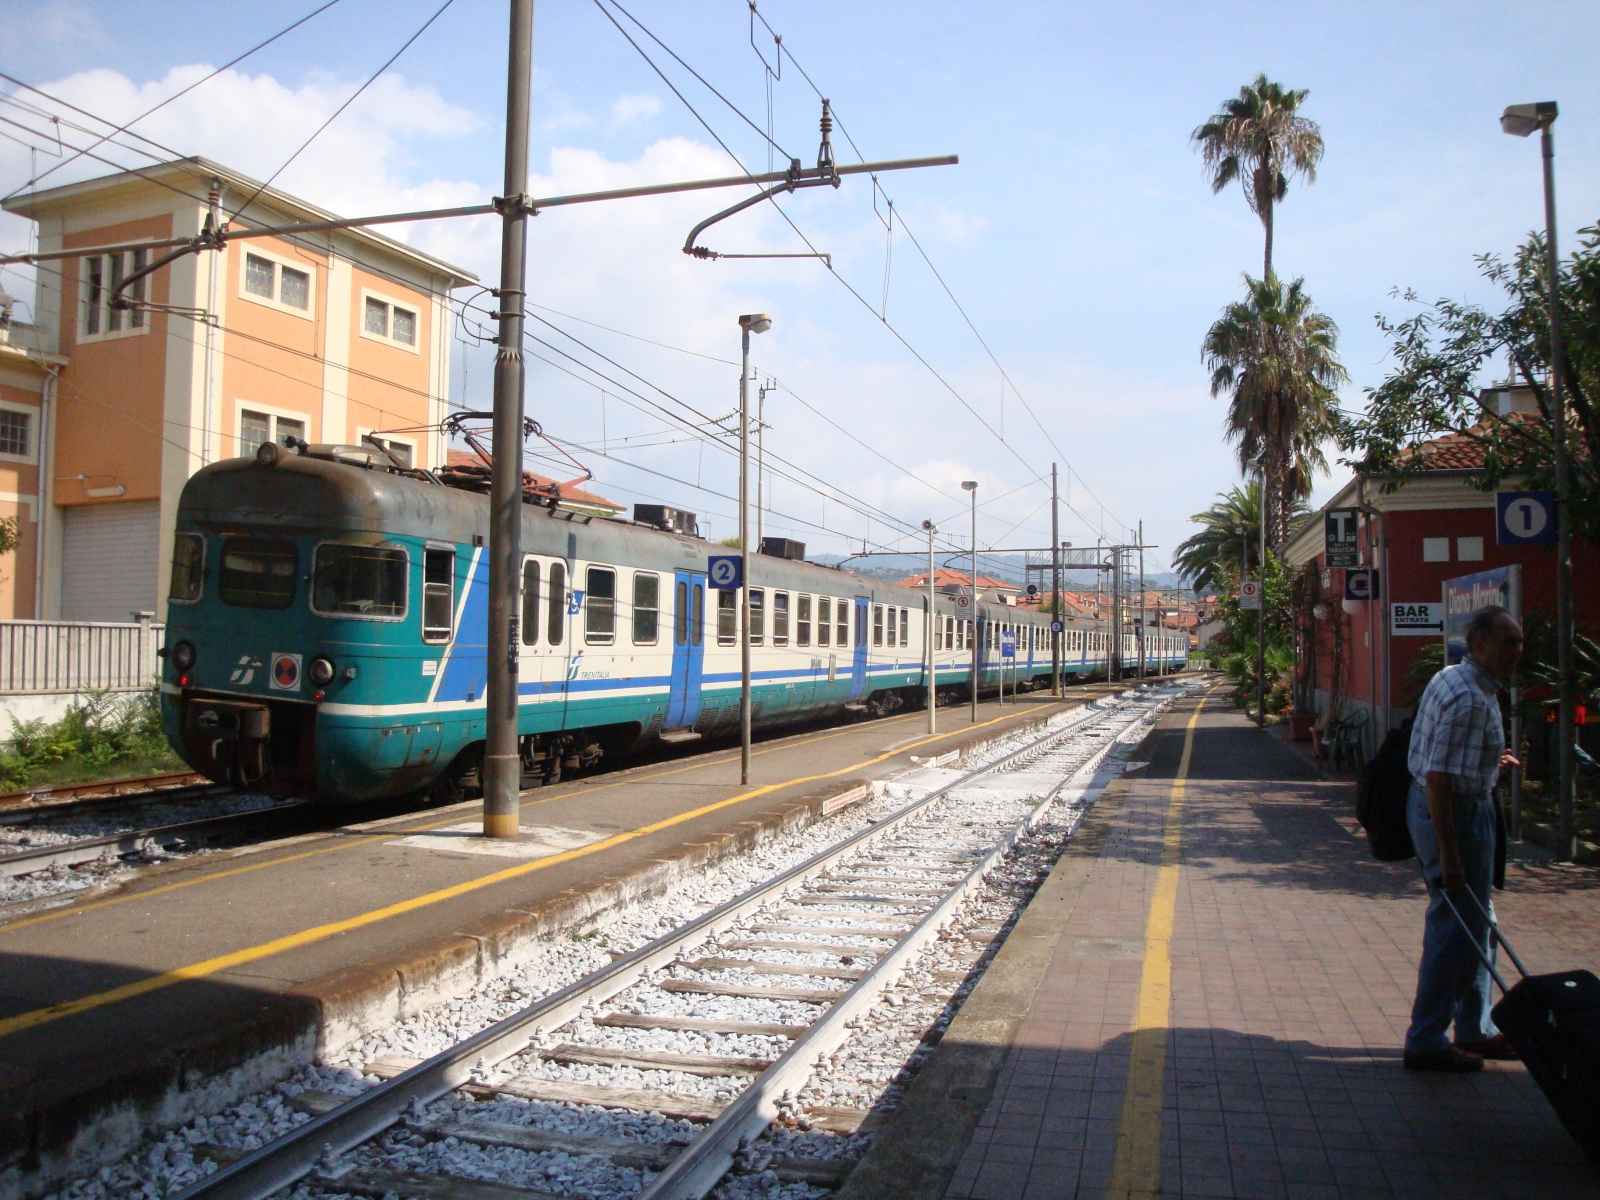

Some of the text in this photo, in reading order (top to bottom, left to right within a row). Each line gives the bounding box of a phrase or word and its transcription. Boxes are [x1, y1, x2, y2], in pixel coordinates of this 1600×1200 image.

[1330, 511, 1352, 543] T
[1519, 505, 1531, 531] 1
[717, 563, 730, 581] 2
[1394, 605, 1429, 617] BAR
[581, 670, 610, 680] TRENITALIA
